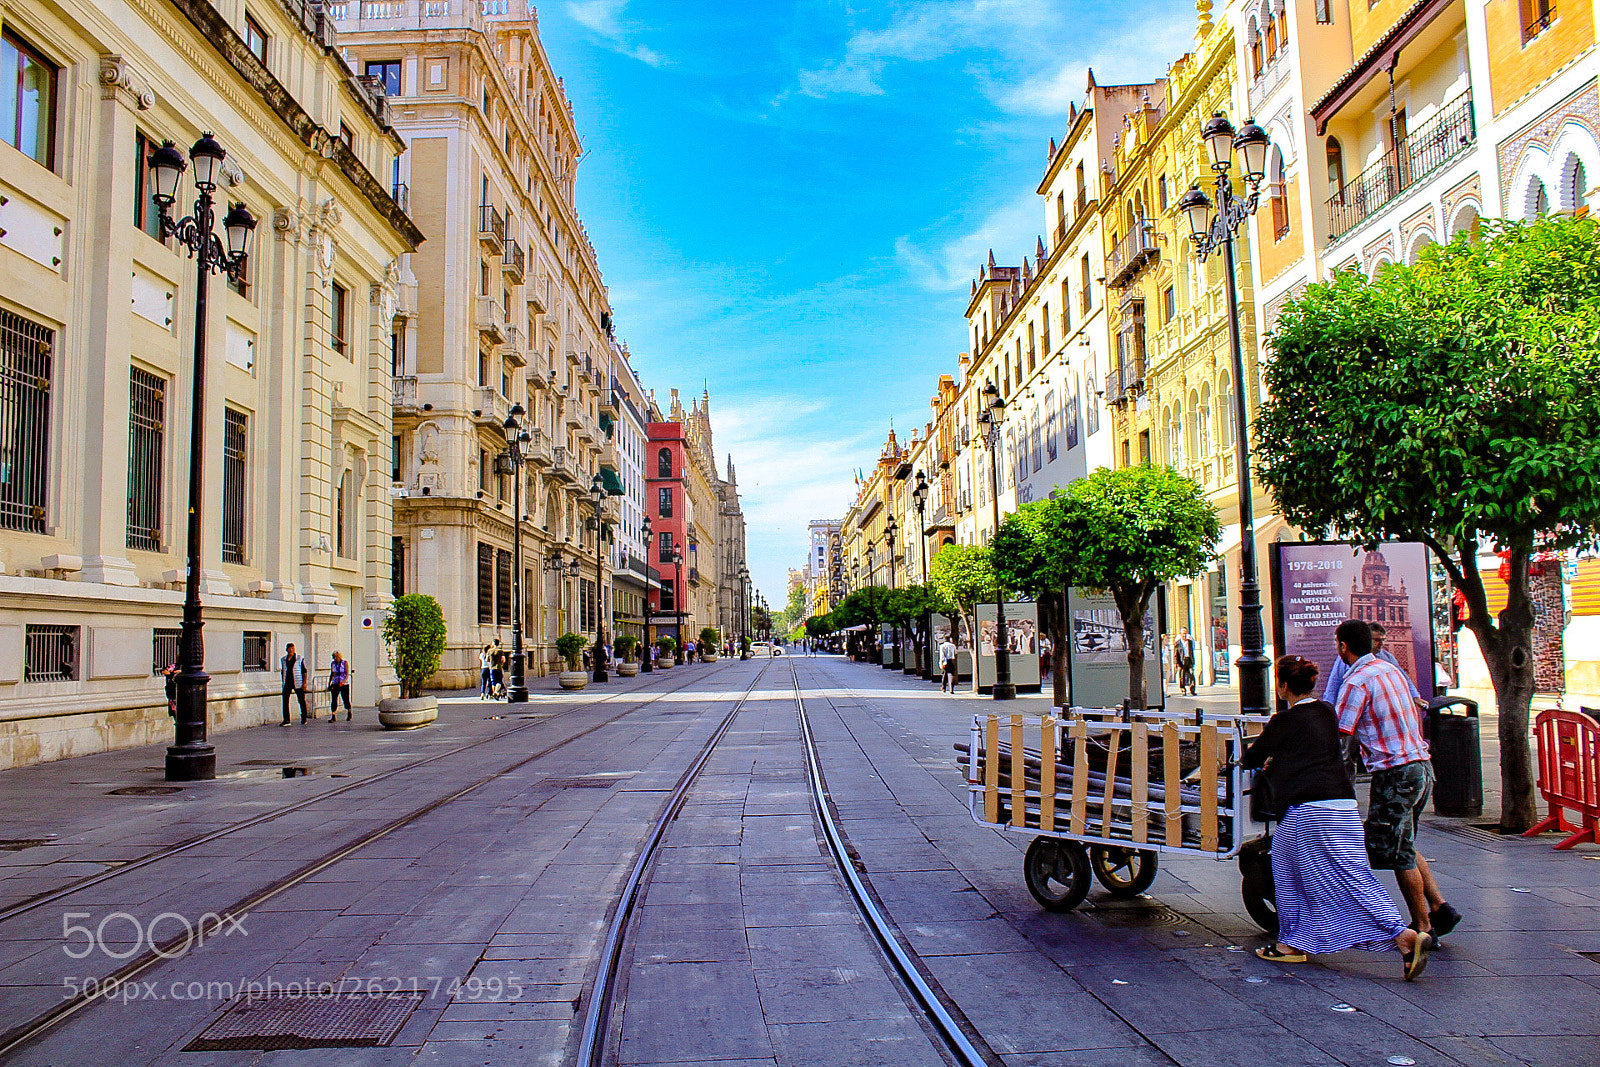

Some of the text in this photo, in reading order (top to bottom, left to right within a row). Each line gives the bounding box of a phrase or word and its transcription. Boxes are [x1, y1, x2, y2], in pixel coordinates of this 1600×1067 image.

[1288, 561, 1343, 570] 1978-2018
[1290, 596, 1344, 604] MANIFESTACIÓN
[1304, 619, 1342, 627] ANDALUCÍA
